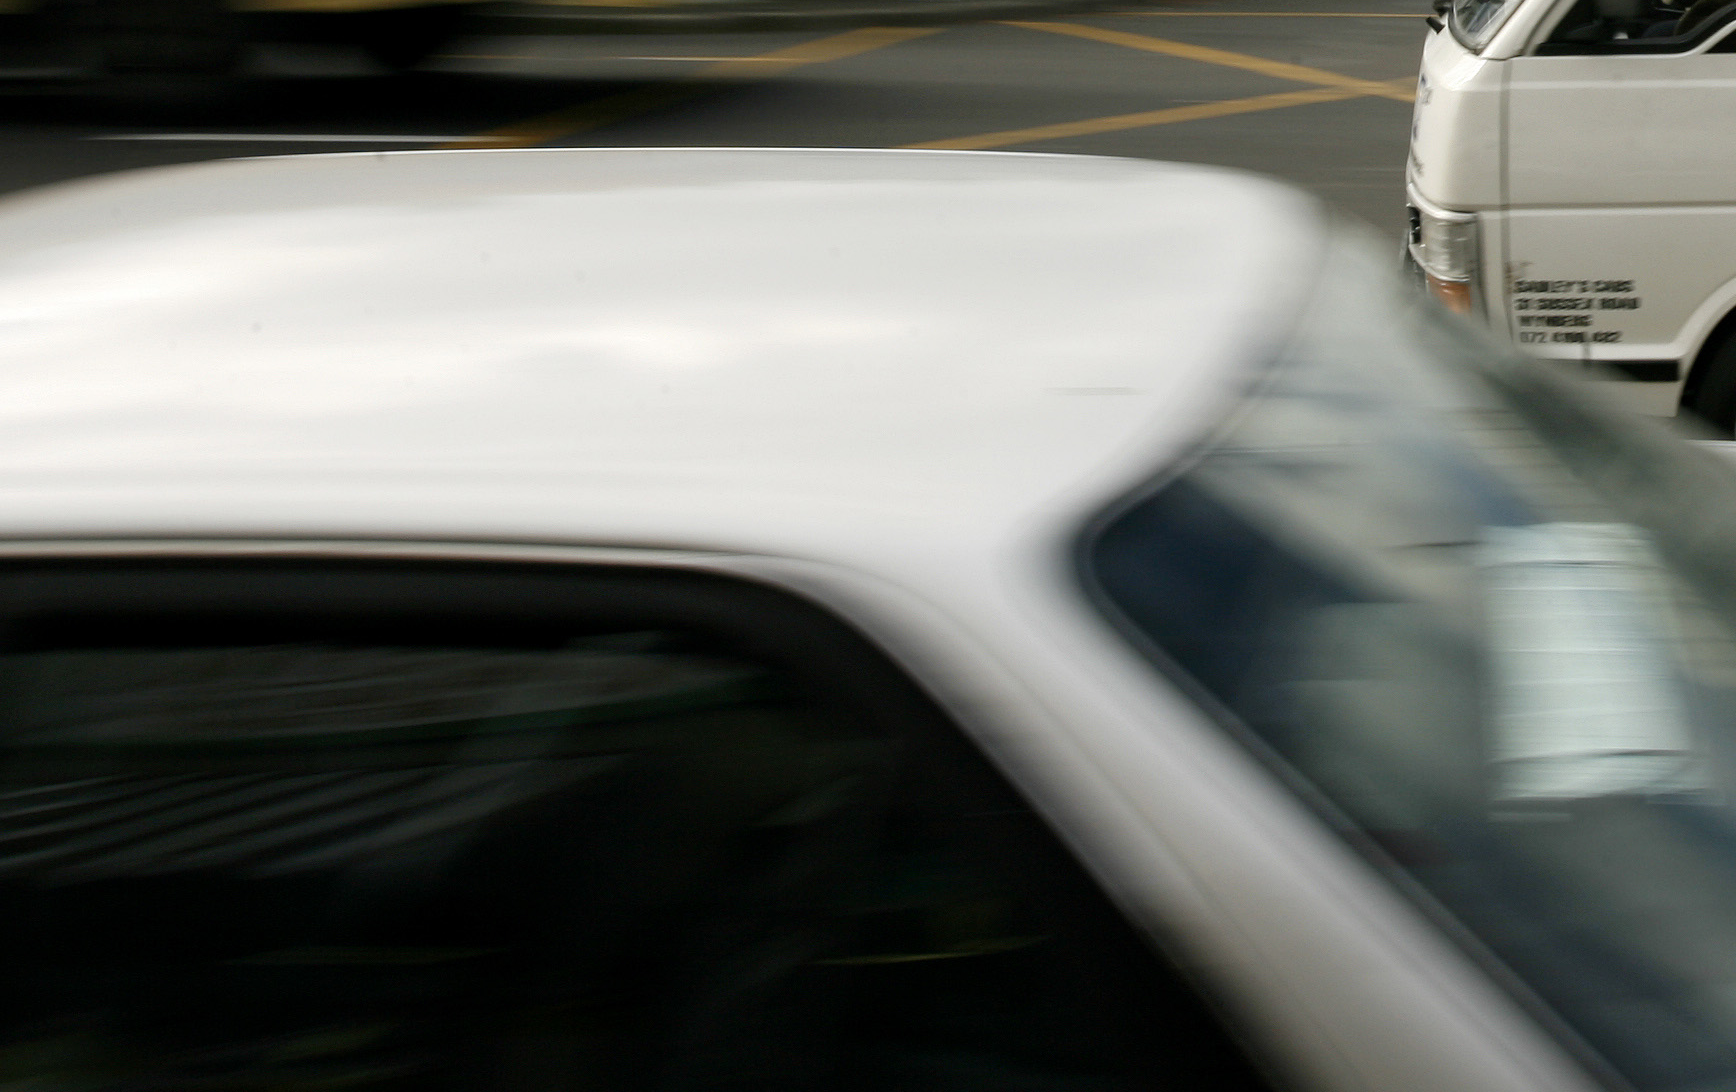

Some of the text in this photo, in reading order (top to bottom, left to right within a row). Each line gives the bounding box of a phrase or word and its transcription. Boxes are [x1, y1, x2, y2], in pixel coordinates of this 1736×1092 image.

[1592, 279, 1636, 293] CABS
[1599, 297, 1641, 310] ROAD
[1517, 314, 1593, 327] WYNBERG
